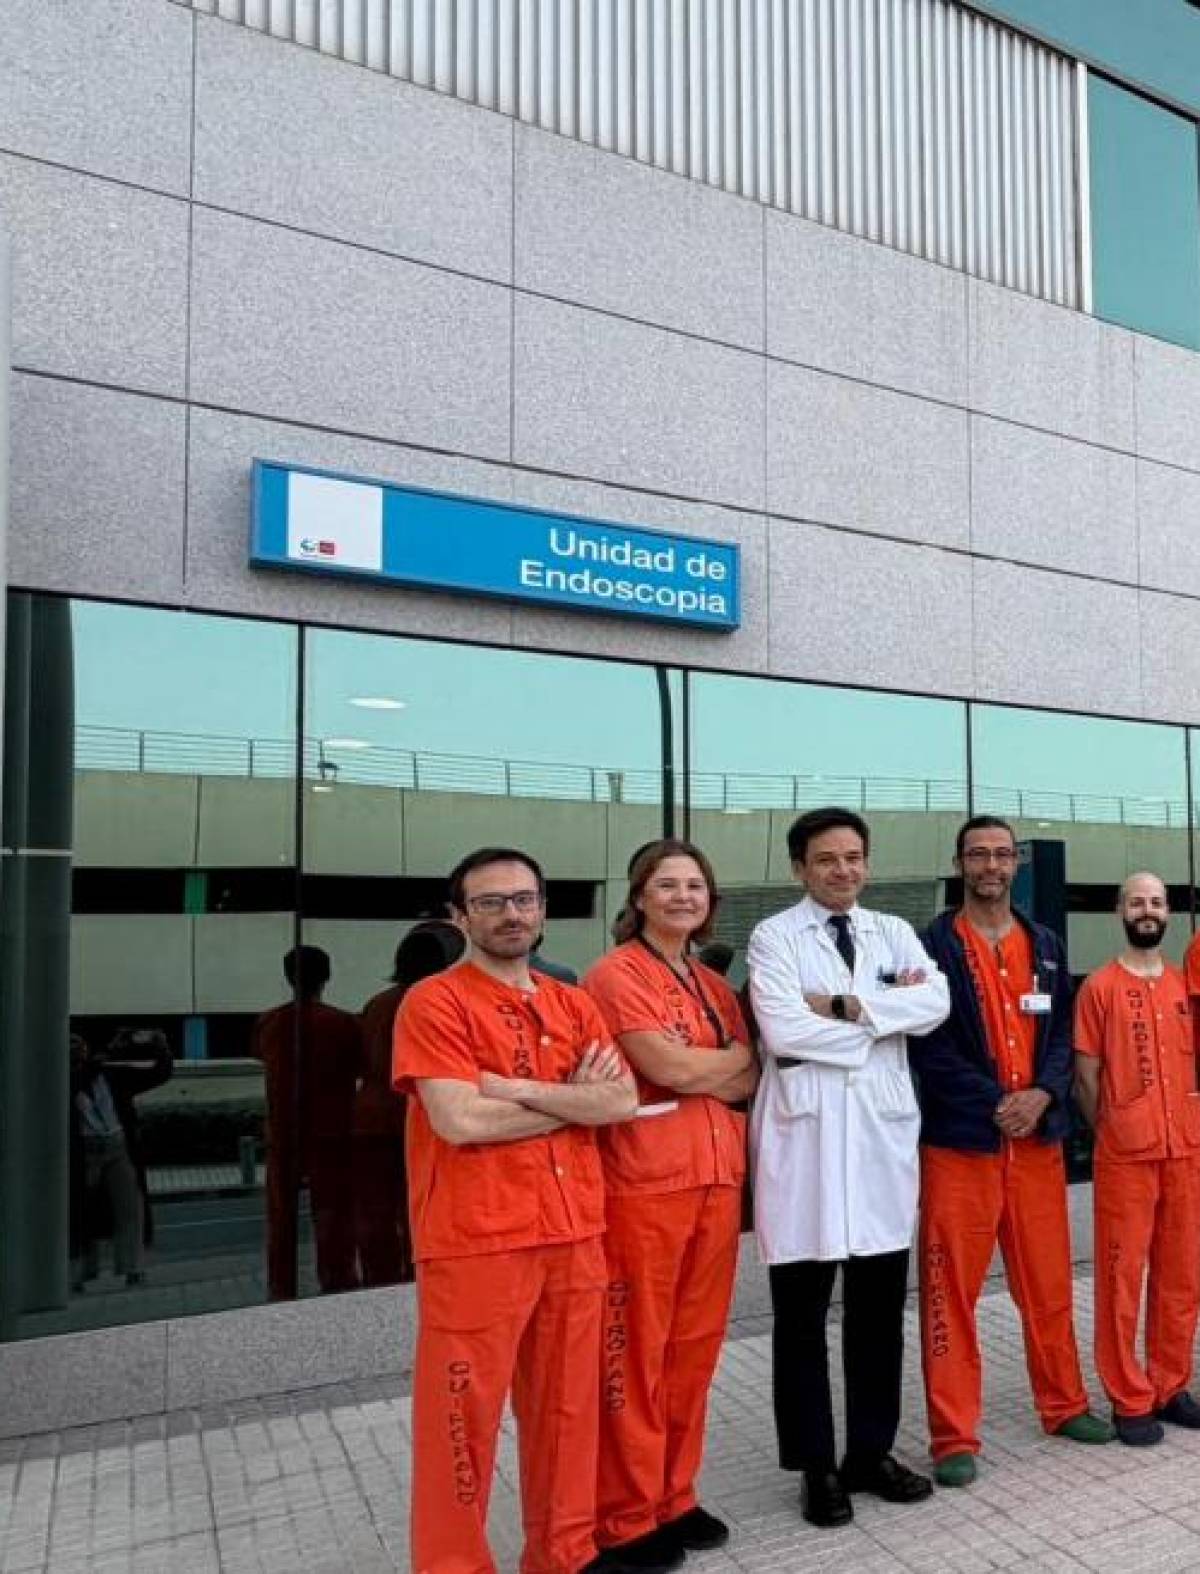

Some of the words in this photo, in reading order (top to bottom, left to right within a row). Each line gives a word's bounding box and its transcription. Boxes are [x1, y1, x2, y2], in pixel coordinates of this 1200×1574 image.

[550, 528, 674, 573] Unidad
[686, 553, 726, 580] de
[521, 559, 727, 614] Endoscopia
